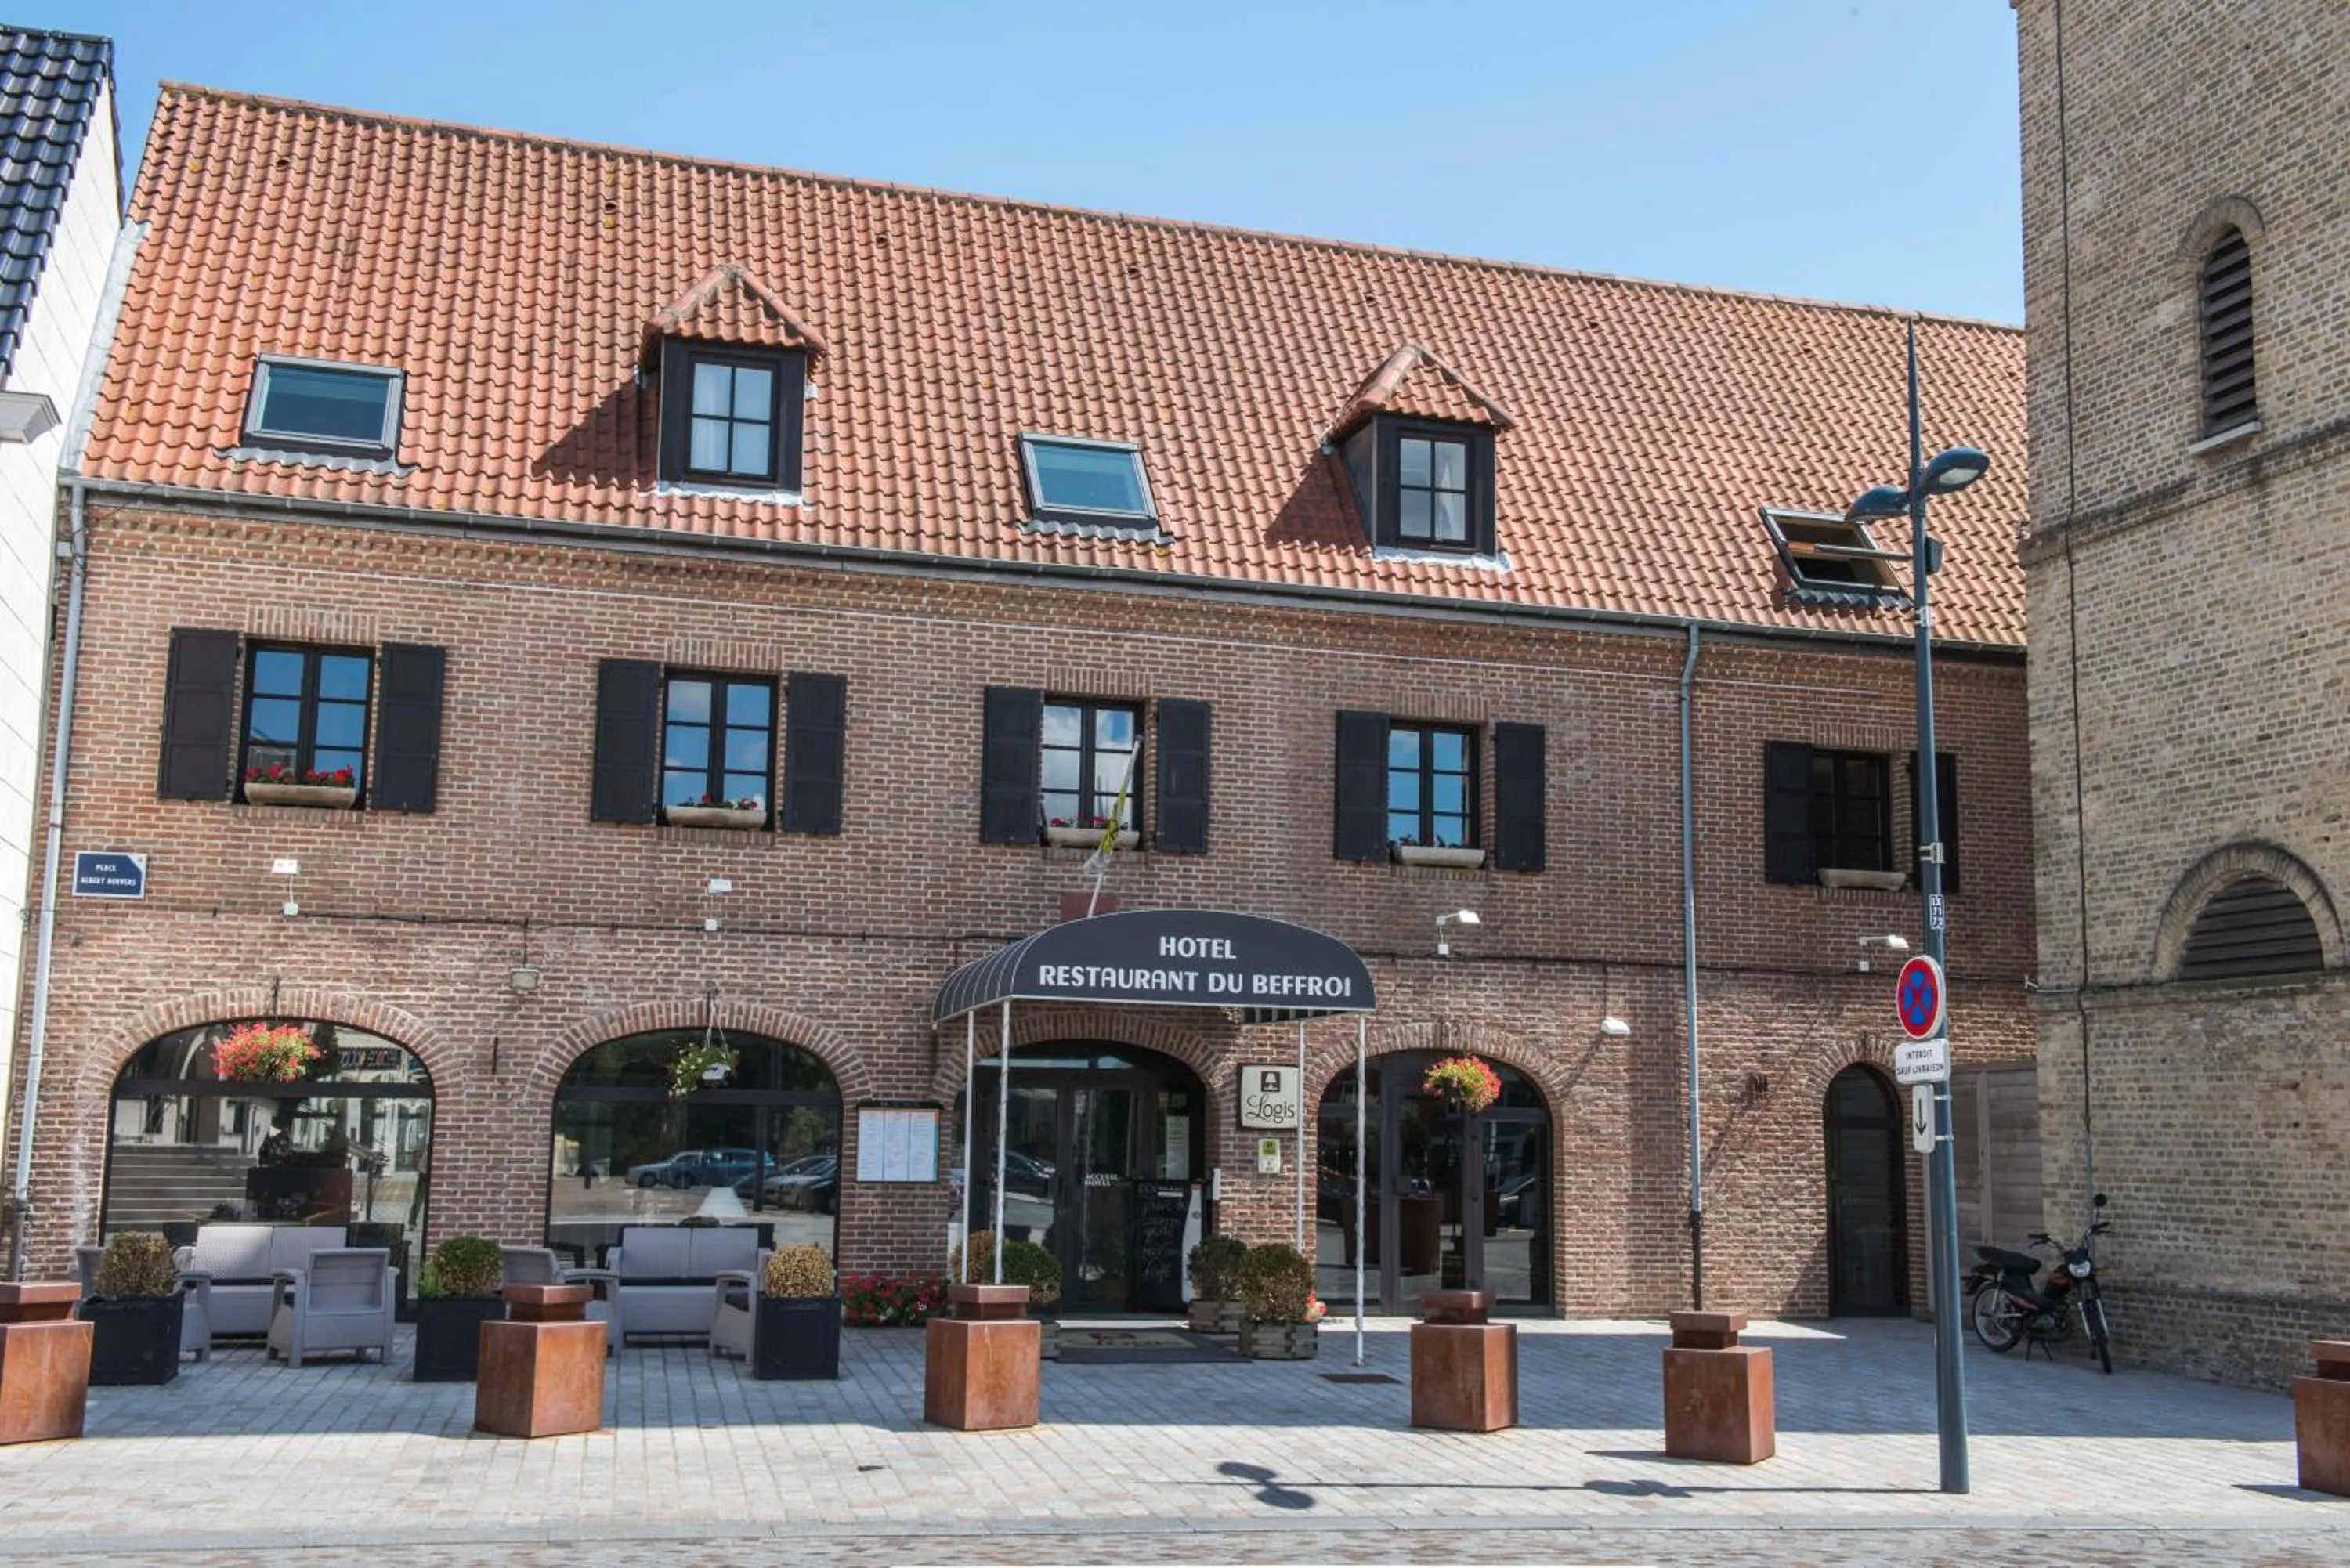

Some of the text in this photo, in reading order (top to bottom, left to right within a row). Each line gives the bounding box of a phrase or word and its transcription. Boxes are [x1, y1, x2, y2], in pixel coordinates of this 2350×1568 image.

[1159, 935, 1237, 959] HOTEL
[1039, 964, 1351, 997] RESTAURANT DU BEFFROI
[1905, 1049, 1933, 1060] INTERDIT
[1896, 1066, 1911, 1075] SAUF
[1246, 1093, 1295, 1124] Logis
